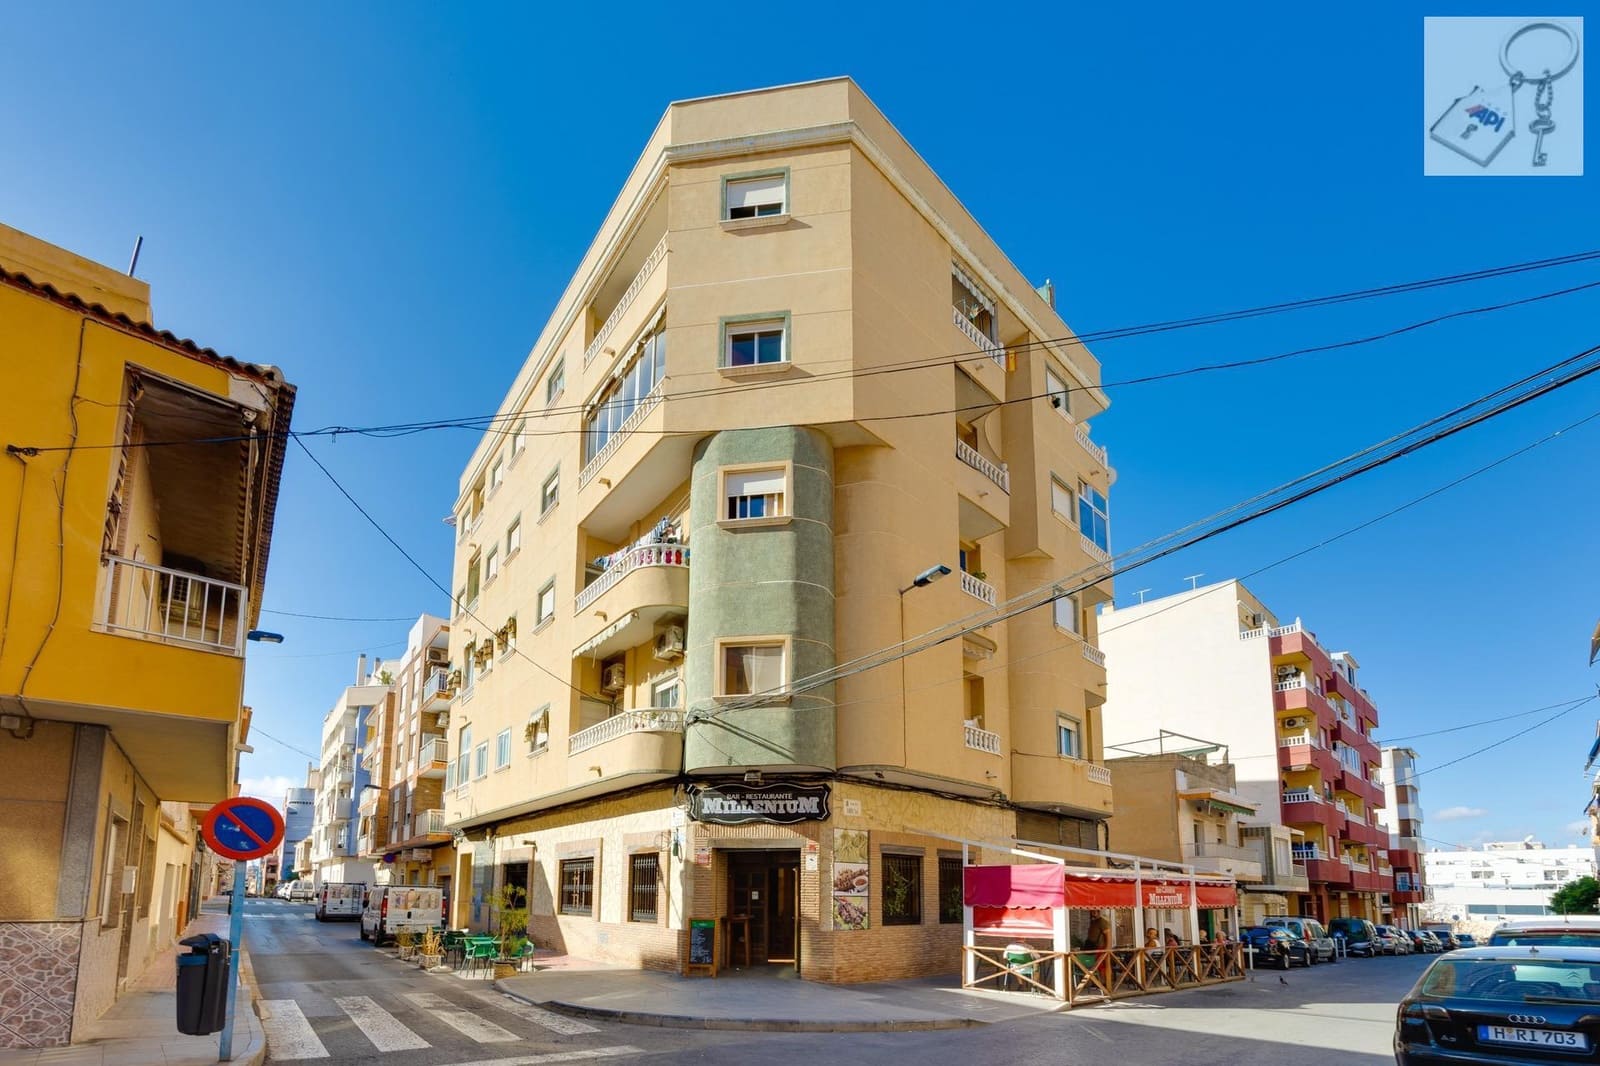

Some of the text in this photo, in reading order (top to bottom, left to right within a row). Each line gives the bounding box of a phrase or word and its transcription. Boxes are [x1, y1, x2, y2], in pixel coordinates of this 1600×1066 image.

[702, 798, 819, 814] MILLENIUM
[1494, 1027, 1576, 1045] H RI 703
